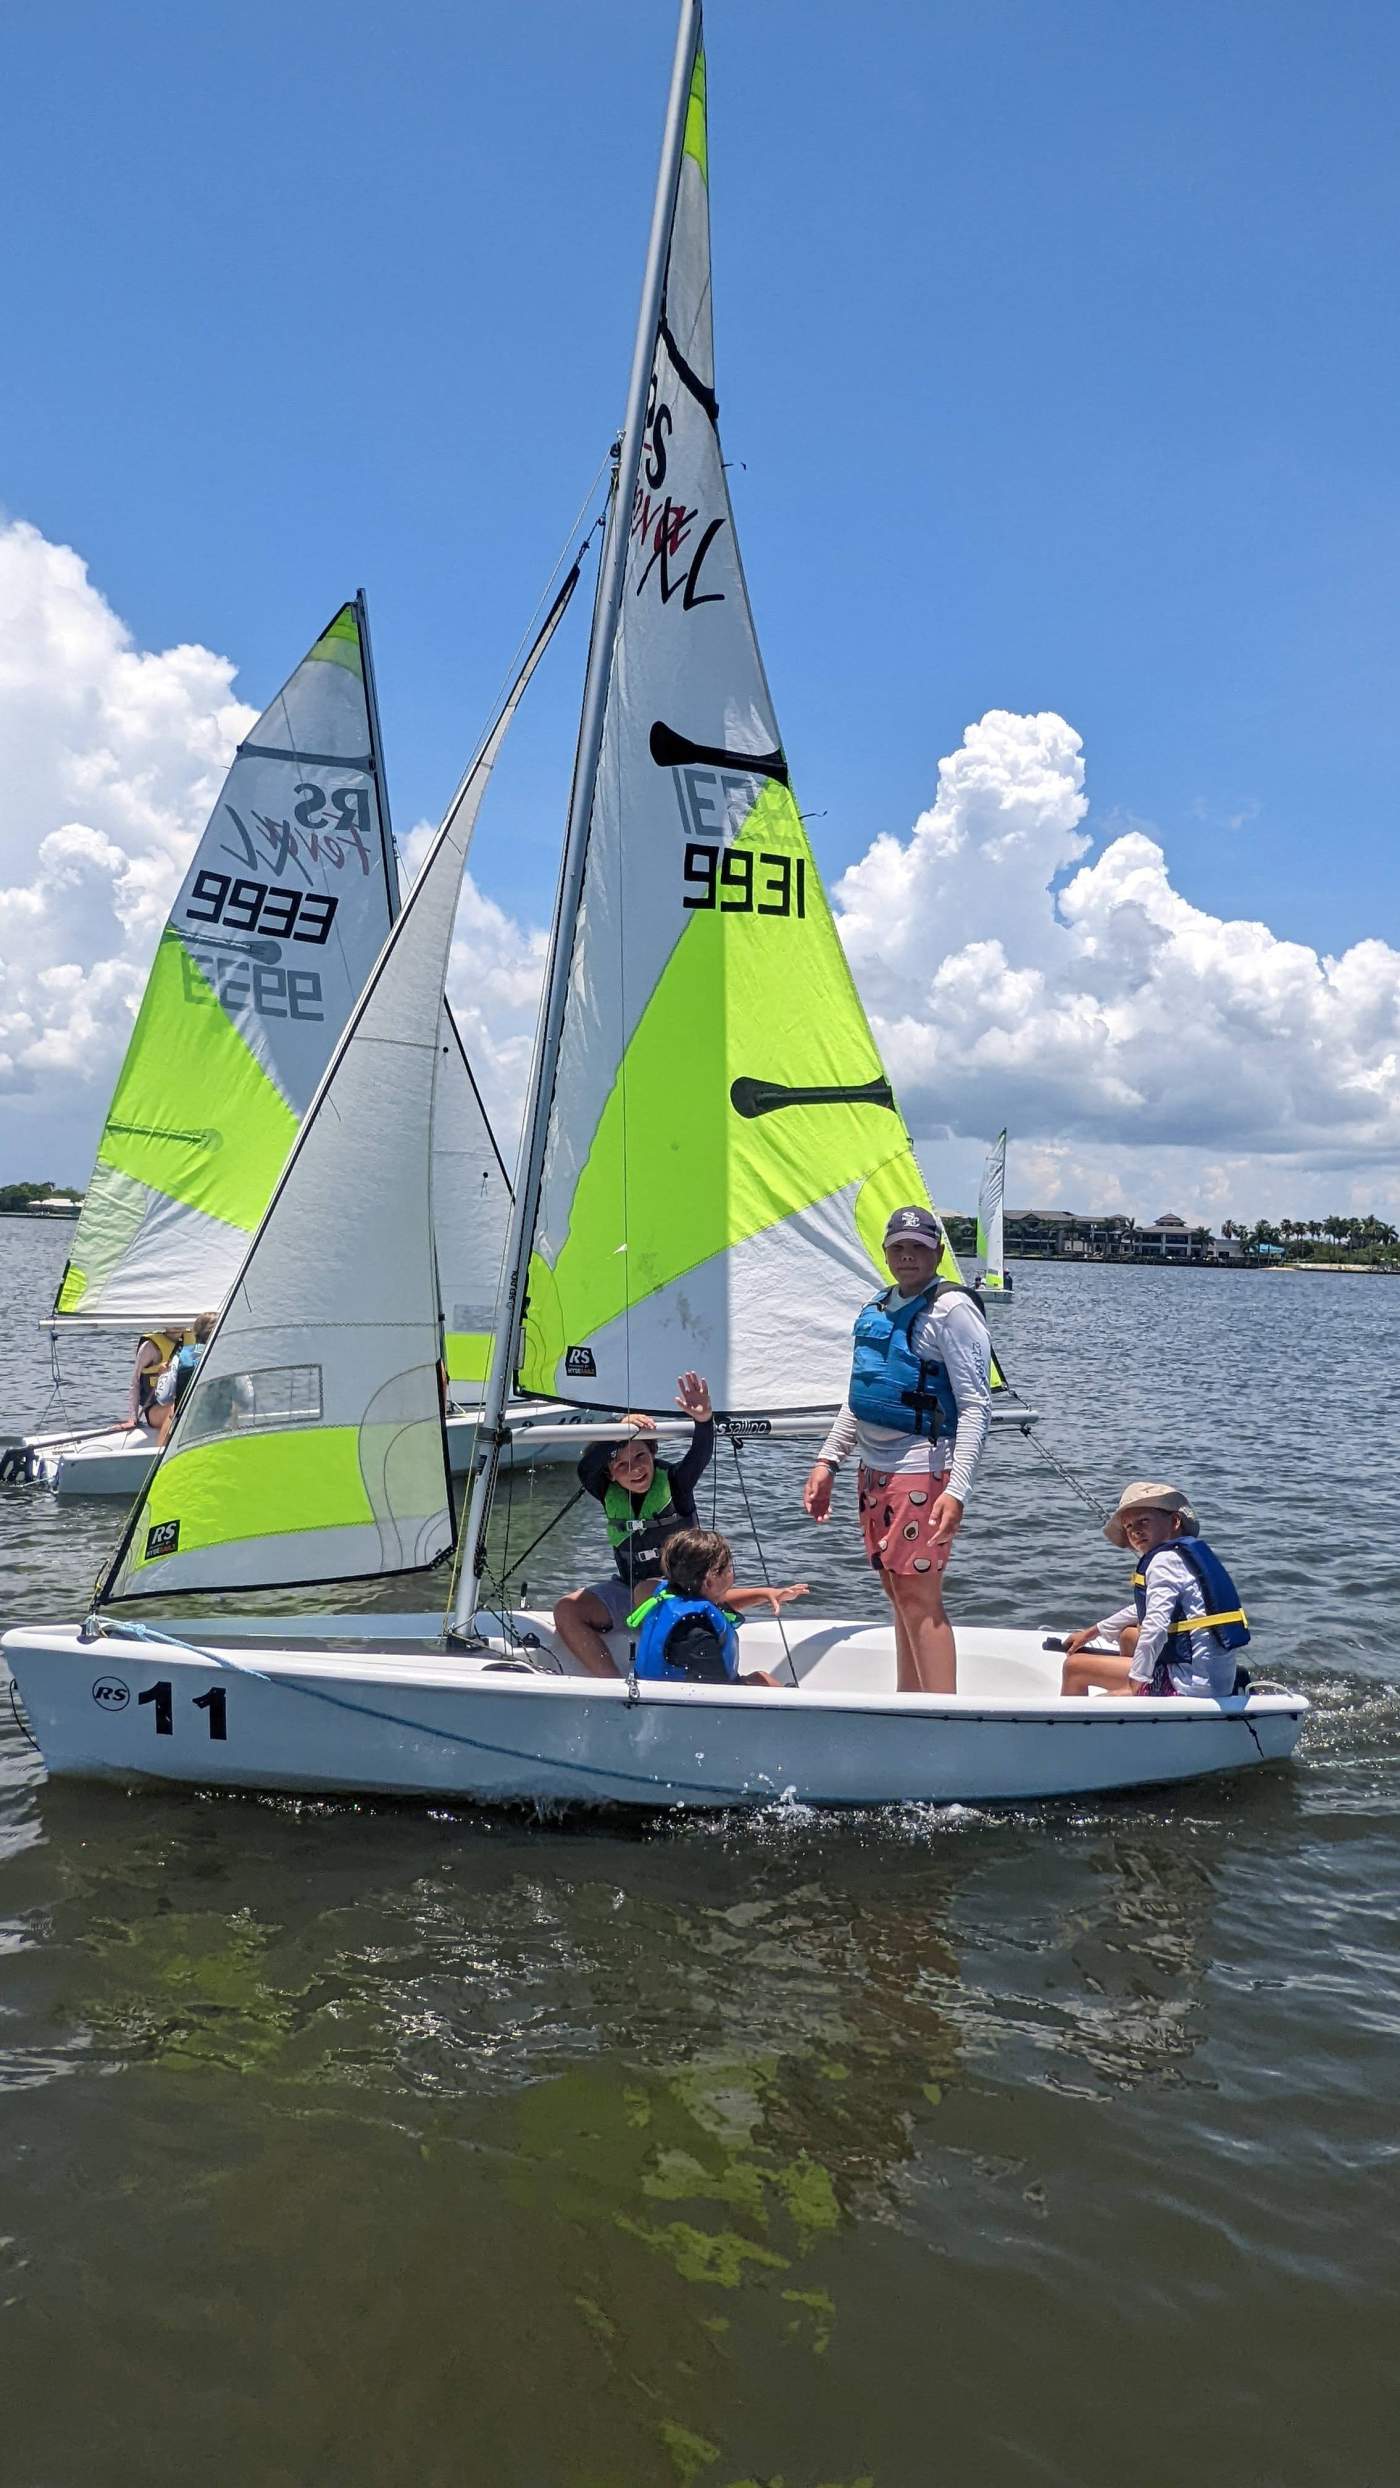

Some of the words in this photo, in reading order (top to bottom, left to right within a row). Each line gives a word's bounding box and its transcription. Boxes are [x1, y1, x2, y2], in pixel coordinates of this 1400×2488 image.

[186, 869, 339, 945] 9933
[682, 843, 806, 919] 9931
[569, 1348, 590, 1364] RS
[152, 1522, 177, 1545] RS
[95, 1686, 128, 1701] RS
[138, 1680, 228, 1741] 11
